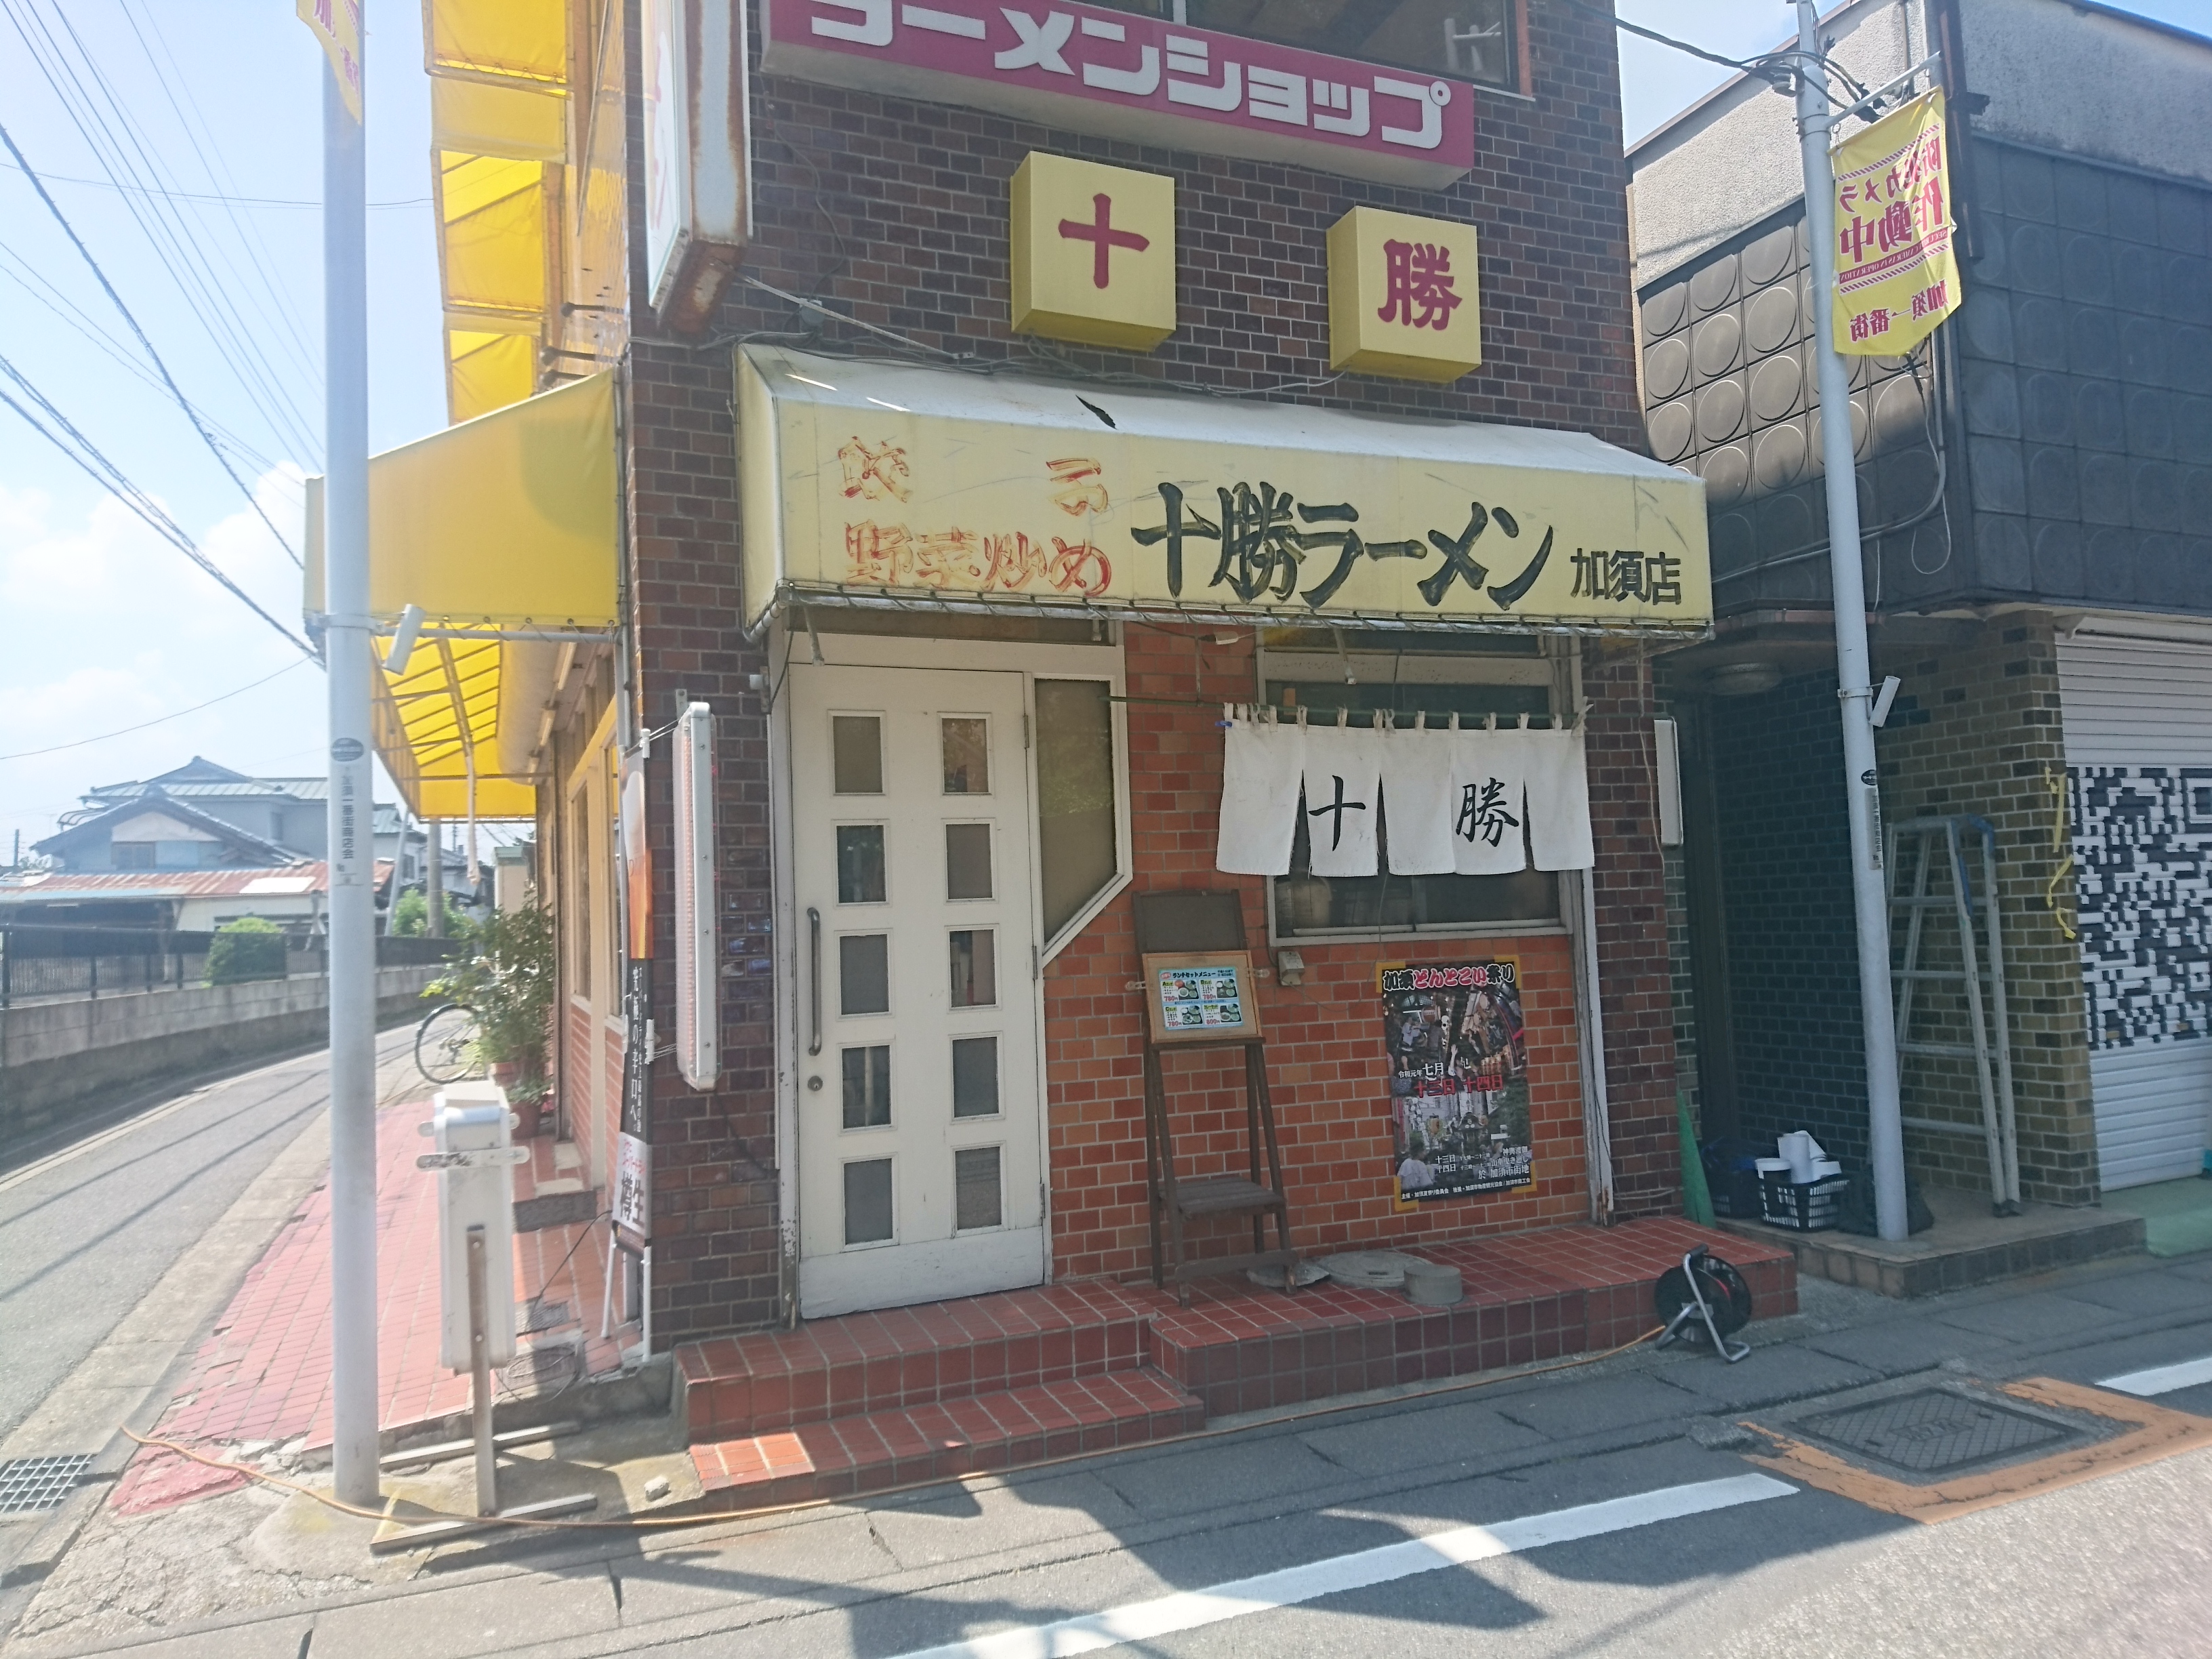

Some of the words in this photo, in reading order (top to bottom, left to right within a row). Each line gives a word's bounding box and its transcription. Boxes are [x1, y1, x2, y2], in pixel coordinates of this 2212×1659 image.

[808, 0, 1451, 149] ラーメンショップ
[1058, 192, 1149, 289] 十
[1378, 238, 1462, 331] 勝
[1130, 481, 1553, 611] 十勝ラーメン
[1570, 548, 1682, 605] 加須店
[1308, 775, 1366, 852] 十
[1455, 777, 1520, 847] 勝
[1382, 963, 1515, 991] 加須どんとこい祭り
[1398, 1062, 1444, 1079] 令和元年七月
[1414, 1078, 1456, 1098] 十三日
[1462, 1074, 1504, 1093] 十四日
[1435, 1154, 1456, 1164] 十三日
[1437, 1164, 1456, 1173] 十四日
[1490, 1164, 1530, 1179] 加須市街地
